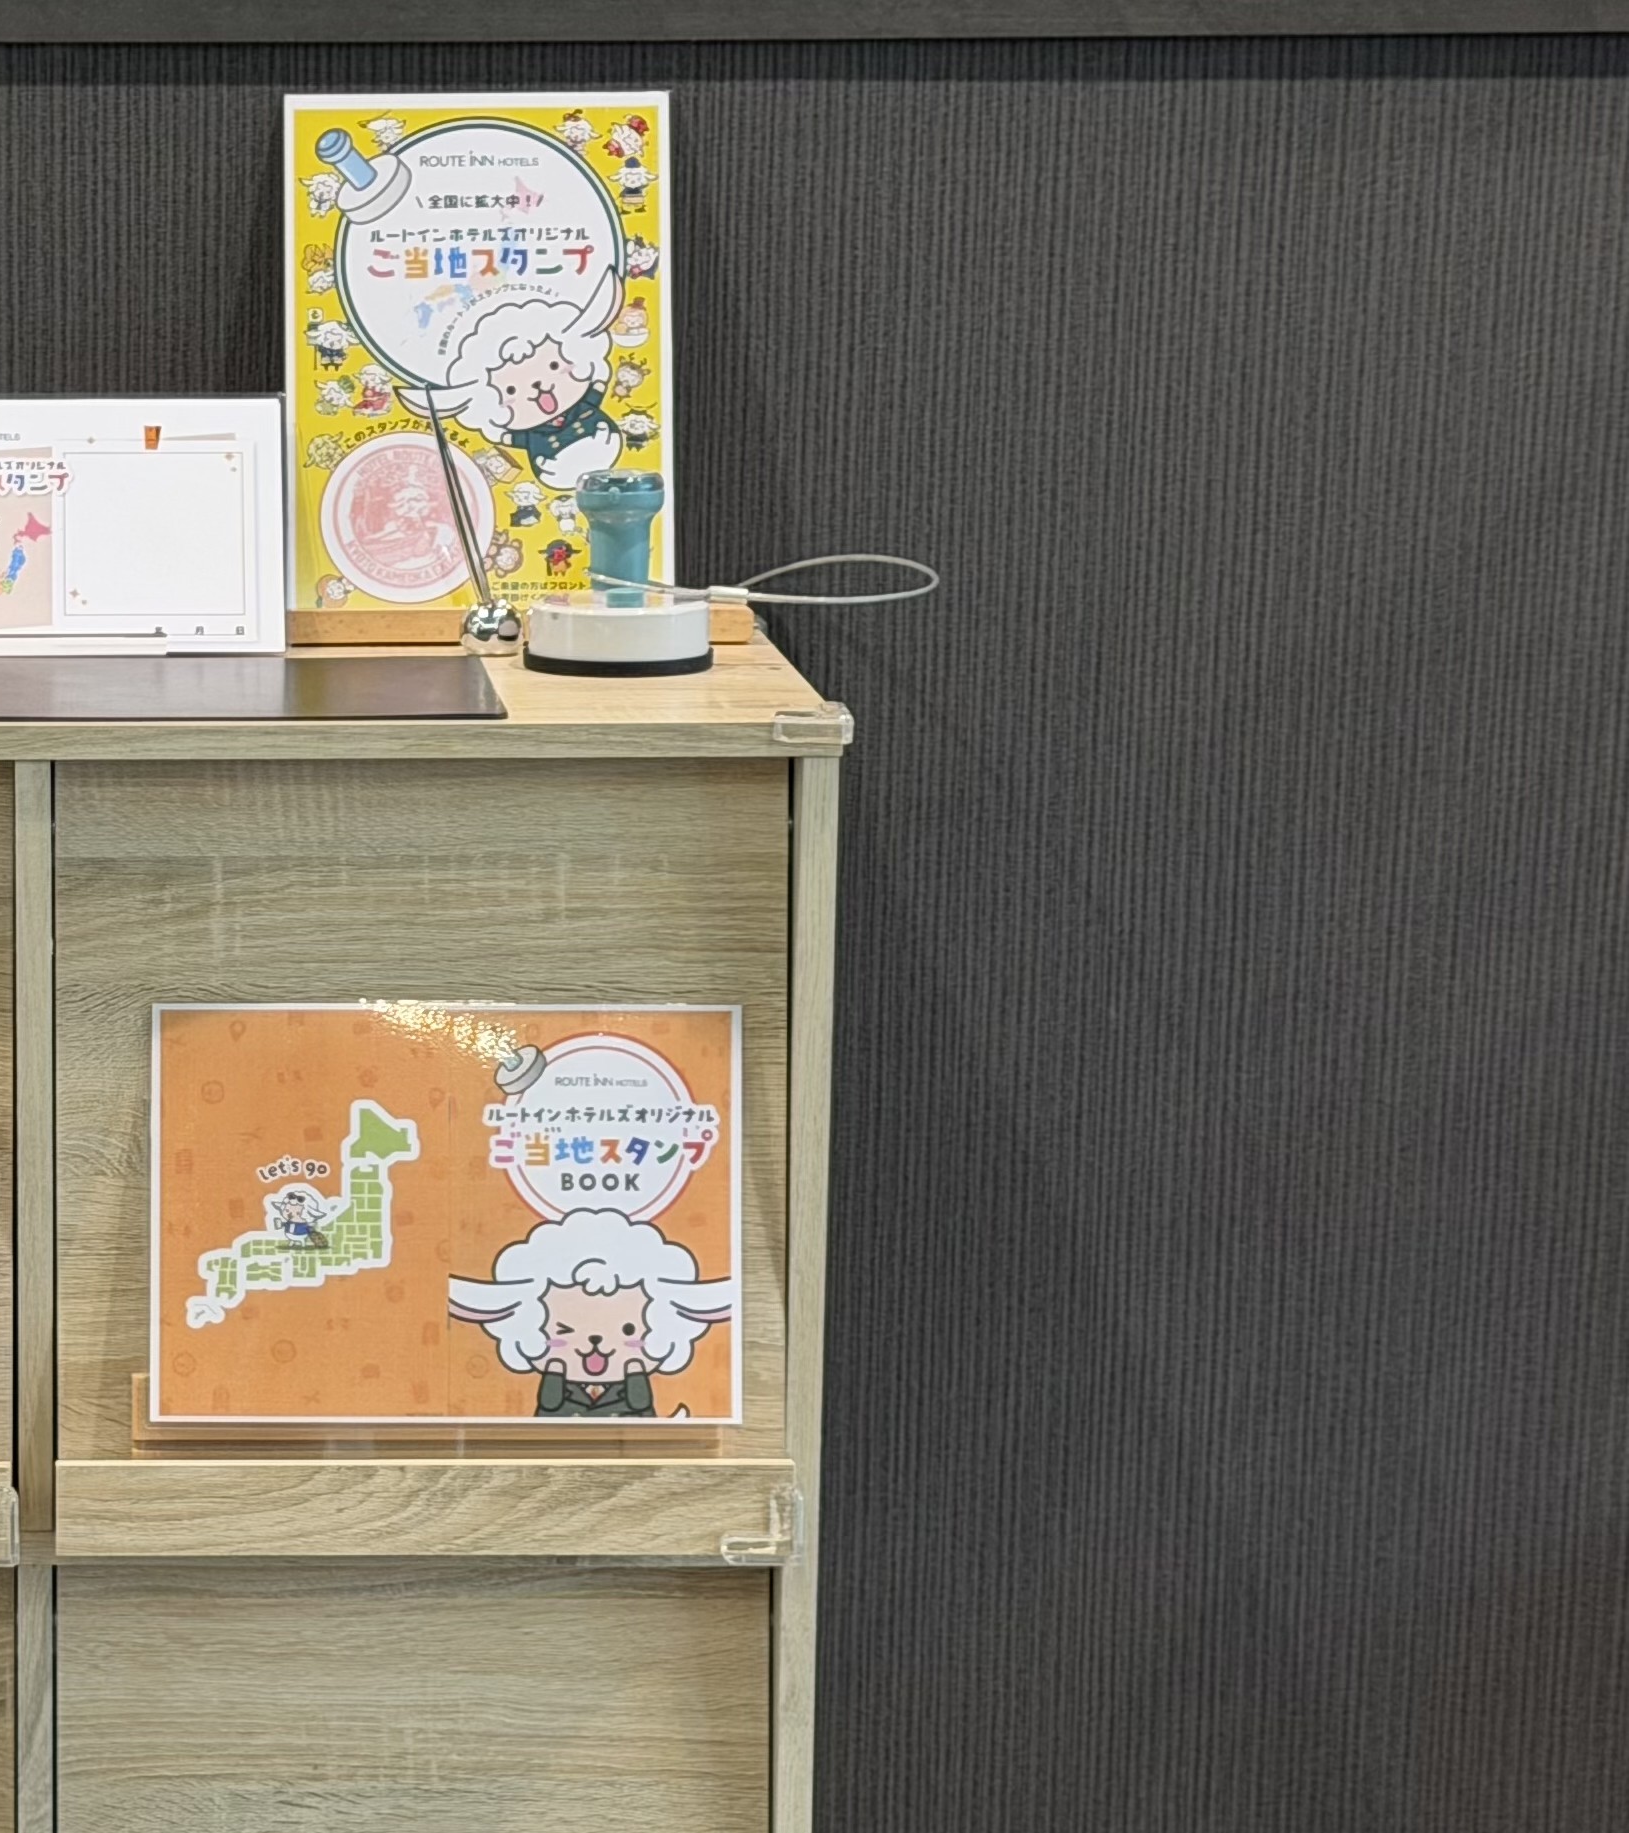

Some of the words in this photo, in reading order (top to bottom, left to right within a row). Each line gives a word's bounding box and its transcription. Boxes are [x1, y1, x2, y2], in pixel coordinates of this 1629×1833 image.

[419, 155, 466, 167] ROUTE
[498, 157, 539, 167] HOTELS
[370, 227, 590, 243] ルートインホテルズオリジナル
[367, 245, 594, 279] ご当地スタンプ
[554, 1077, 591, 1087] ROUTE
[494, 1128, 713, 1166] ご当地スタンプ
[306, 1162, 327, 1177] go
[560, 1173, 640, 1191] BOOK
